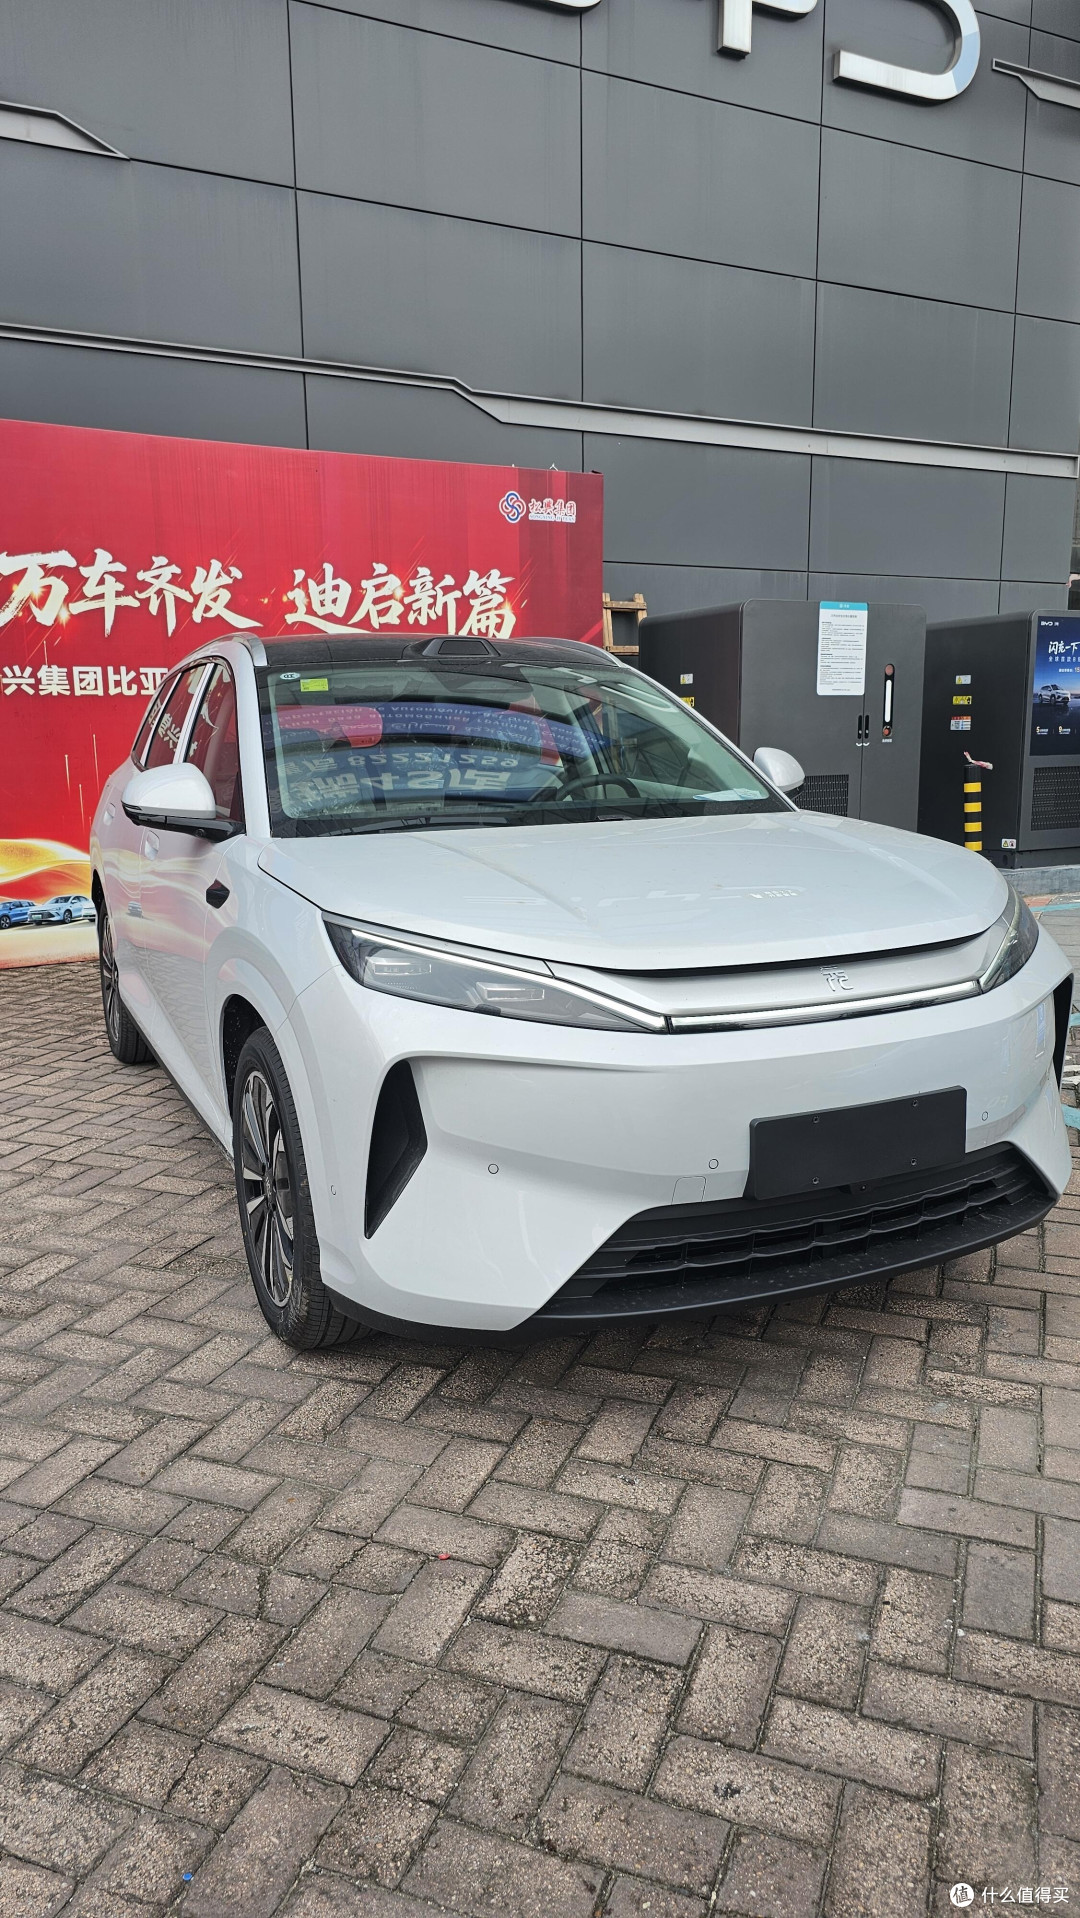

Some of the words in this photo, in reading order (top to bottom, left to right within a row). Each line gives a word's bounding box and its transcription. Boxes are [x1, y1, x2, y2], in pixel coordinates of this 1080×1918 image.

[0, 549, 263, 637] 万车齐发
[285, 562, 516, 639] 迪启新篇
